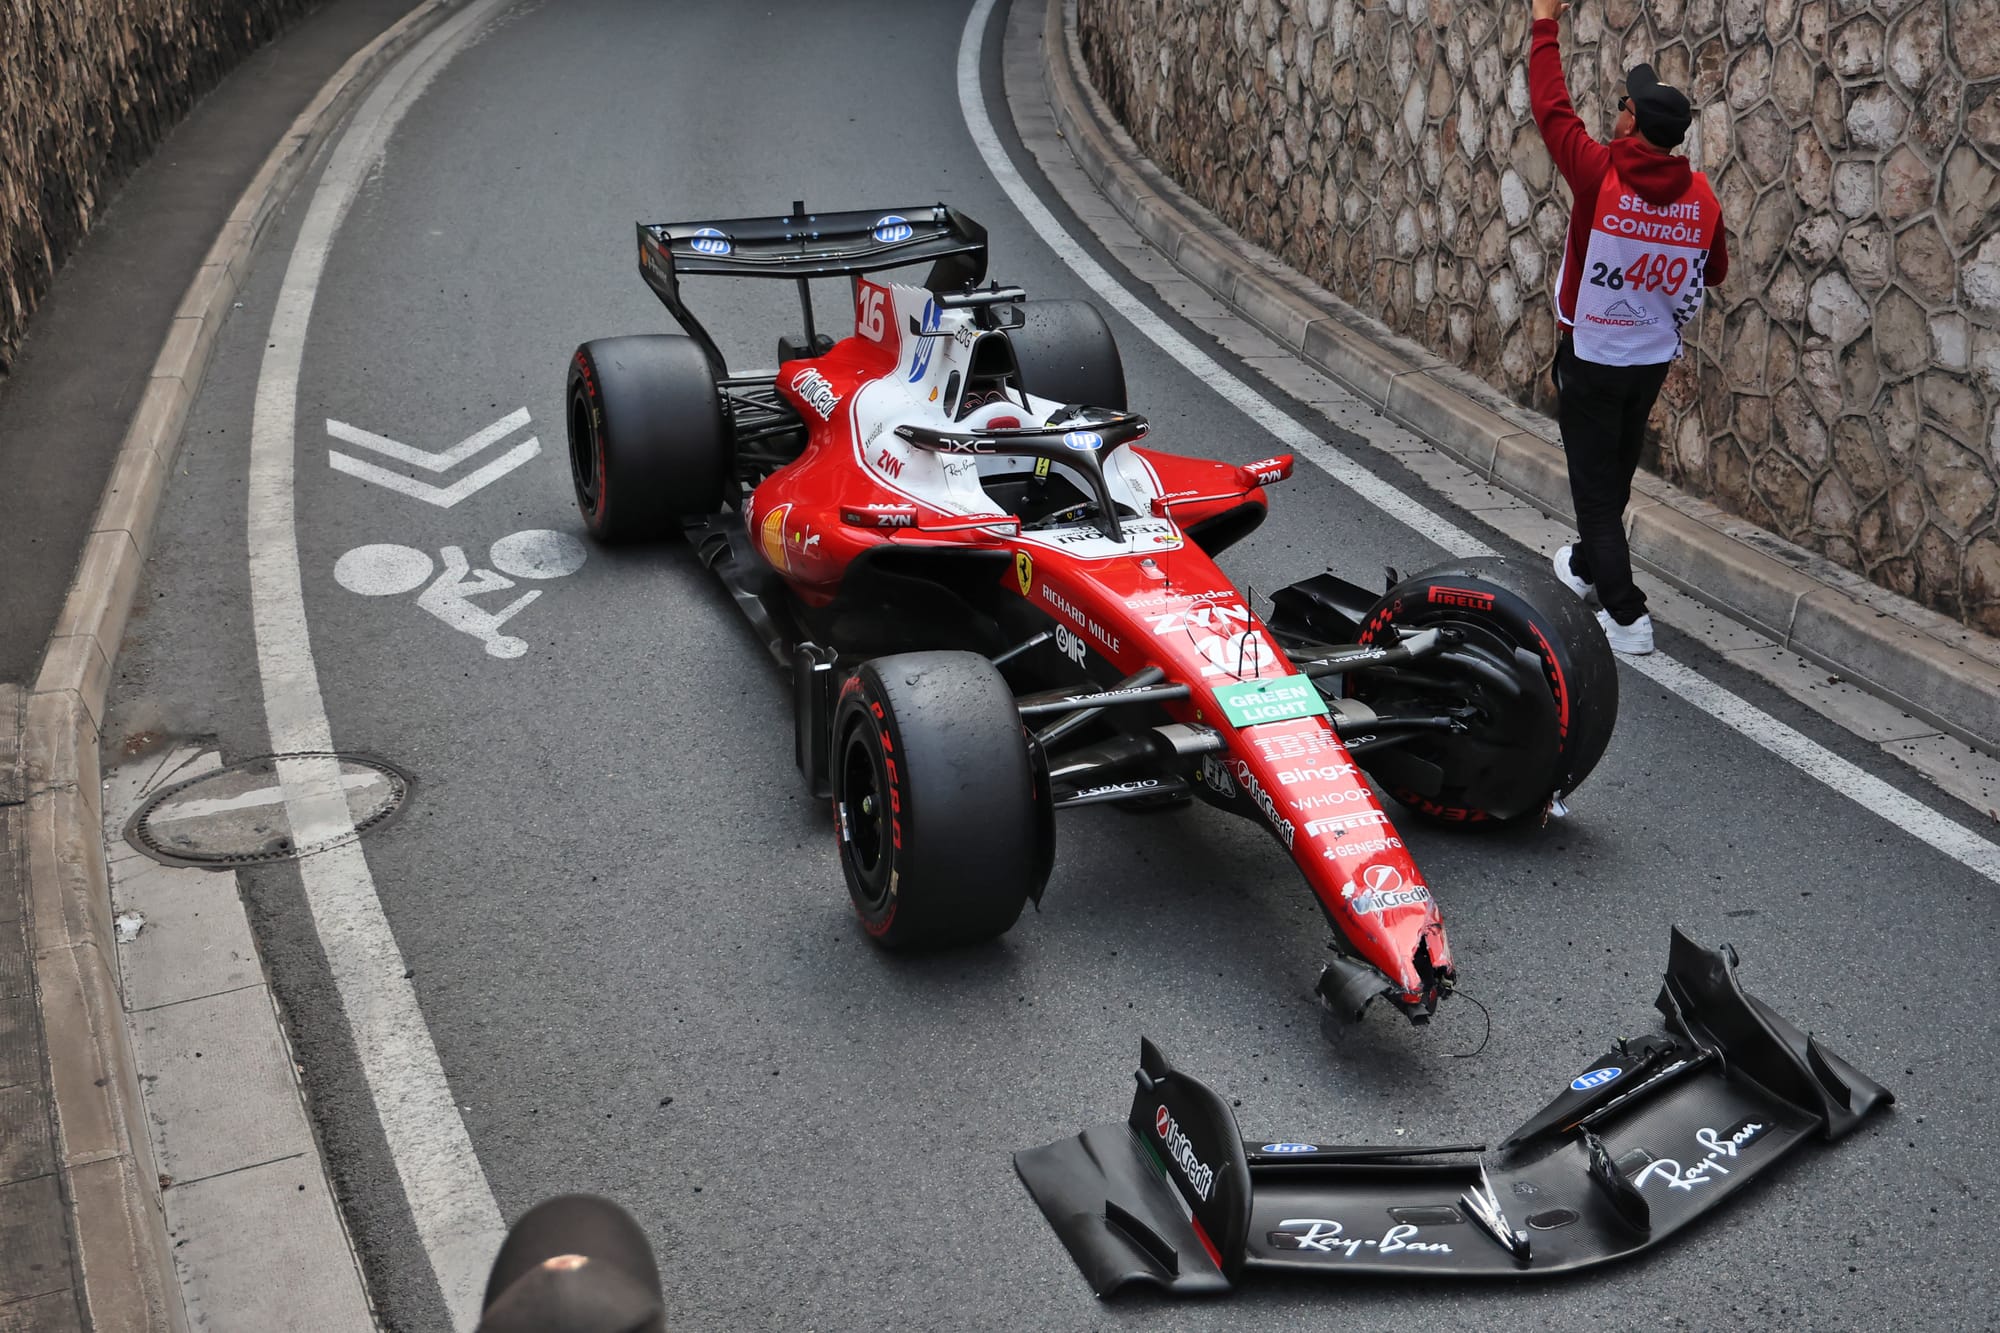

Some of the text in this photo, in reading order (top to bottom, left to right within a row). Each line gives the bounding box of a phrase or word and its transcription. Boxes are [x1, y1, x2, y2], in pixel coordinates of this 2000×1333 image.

[696, 228, 727, 254] hp
[881, 215, 910, 243] hp
[1602, 214, 1702, 244] CONTRÔLE
[1590, 253, 1688, 296] 26 489
[858, 285, 885, 343] 16
[1585, 313, 1635, 327] MONACO
[954, 324, 973, 349] ZCG
[1070, 431, 1098, 450] hp
[877, 449, 905, 480] ZYN
[1258, 469, 1283, 486] ZYN
[877, 514, 913, 527] ZYN
[1124, 589, 1234, 609] Bitdefender
[1428, 585, 1496, 612] PIRELLI
[1042, 583, 1119, 654] RICHARD MILLE
[1144, 604, 1254, 635] ZYN
[1195, 630, 1274, 677] 16
[1331, 650, 1388, 664] vantage
[1086, 686, 1152, 699] vantage
[1228, 686, 1309, 708] GREEN
[1241, 700, 1307, 720] LIGHT
[1253, 728, 1344, 762] IBM
[871, 702, 902, 849] P ZERO
[1077, 779, 1158, 798] ESPACIO
[1248, 773, 1295, 851] UniCredit
[1289, 787, 1372, 812] WHOOP
[1303, 809, 1389, 838] PIRELLI
[1335, 837, 1402, 858] GENESYS
[1580, 1068, 1614, 1090] hp
[1166, 1117, 1214, 1202] UniCredit
[1270, 1143, 1311, 1153] hp
[1633, 1127, 1763, 1191] Ray-Ban
[1278, 1218, 1453, 1257] Ray-Ban
